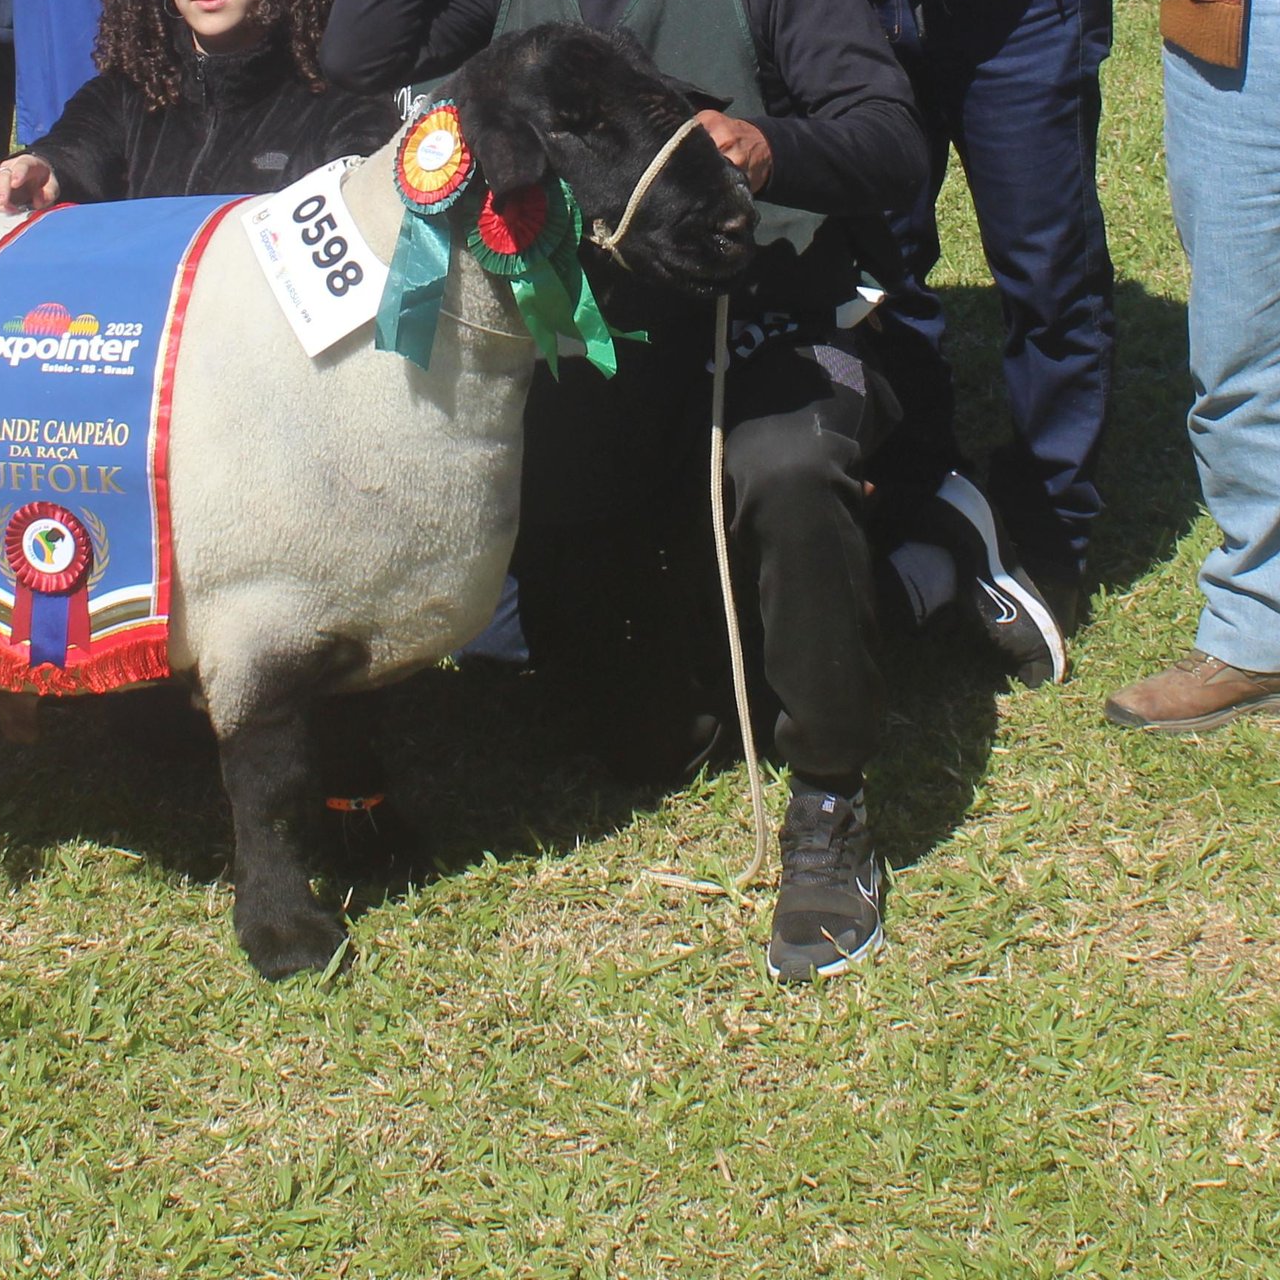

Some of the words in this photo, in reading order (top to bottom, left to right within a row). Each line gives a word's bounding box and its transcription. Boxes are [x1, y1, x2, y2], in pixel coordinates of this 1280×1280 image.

[292, 194, 364, 298] 0598
[259, 228, 279, 263] Expointer
[284, 280, 303, 308] FARSUL
[105, 323, 143, 337] 2023
[41, 363, 73, 374] Esteio
[81, 365, 96, 374] RS
[104, 365, 135, 376] Brasil
[43, 418, 130, 447] CAMPEÃO
[9, 445, 32, 457] DA
[36, 446, 79, 462] RAÇA
